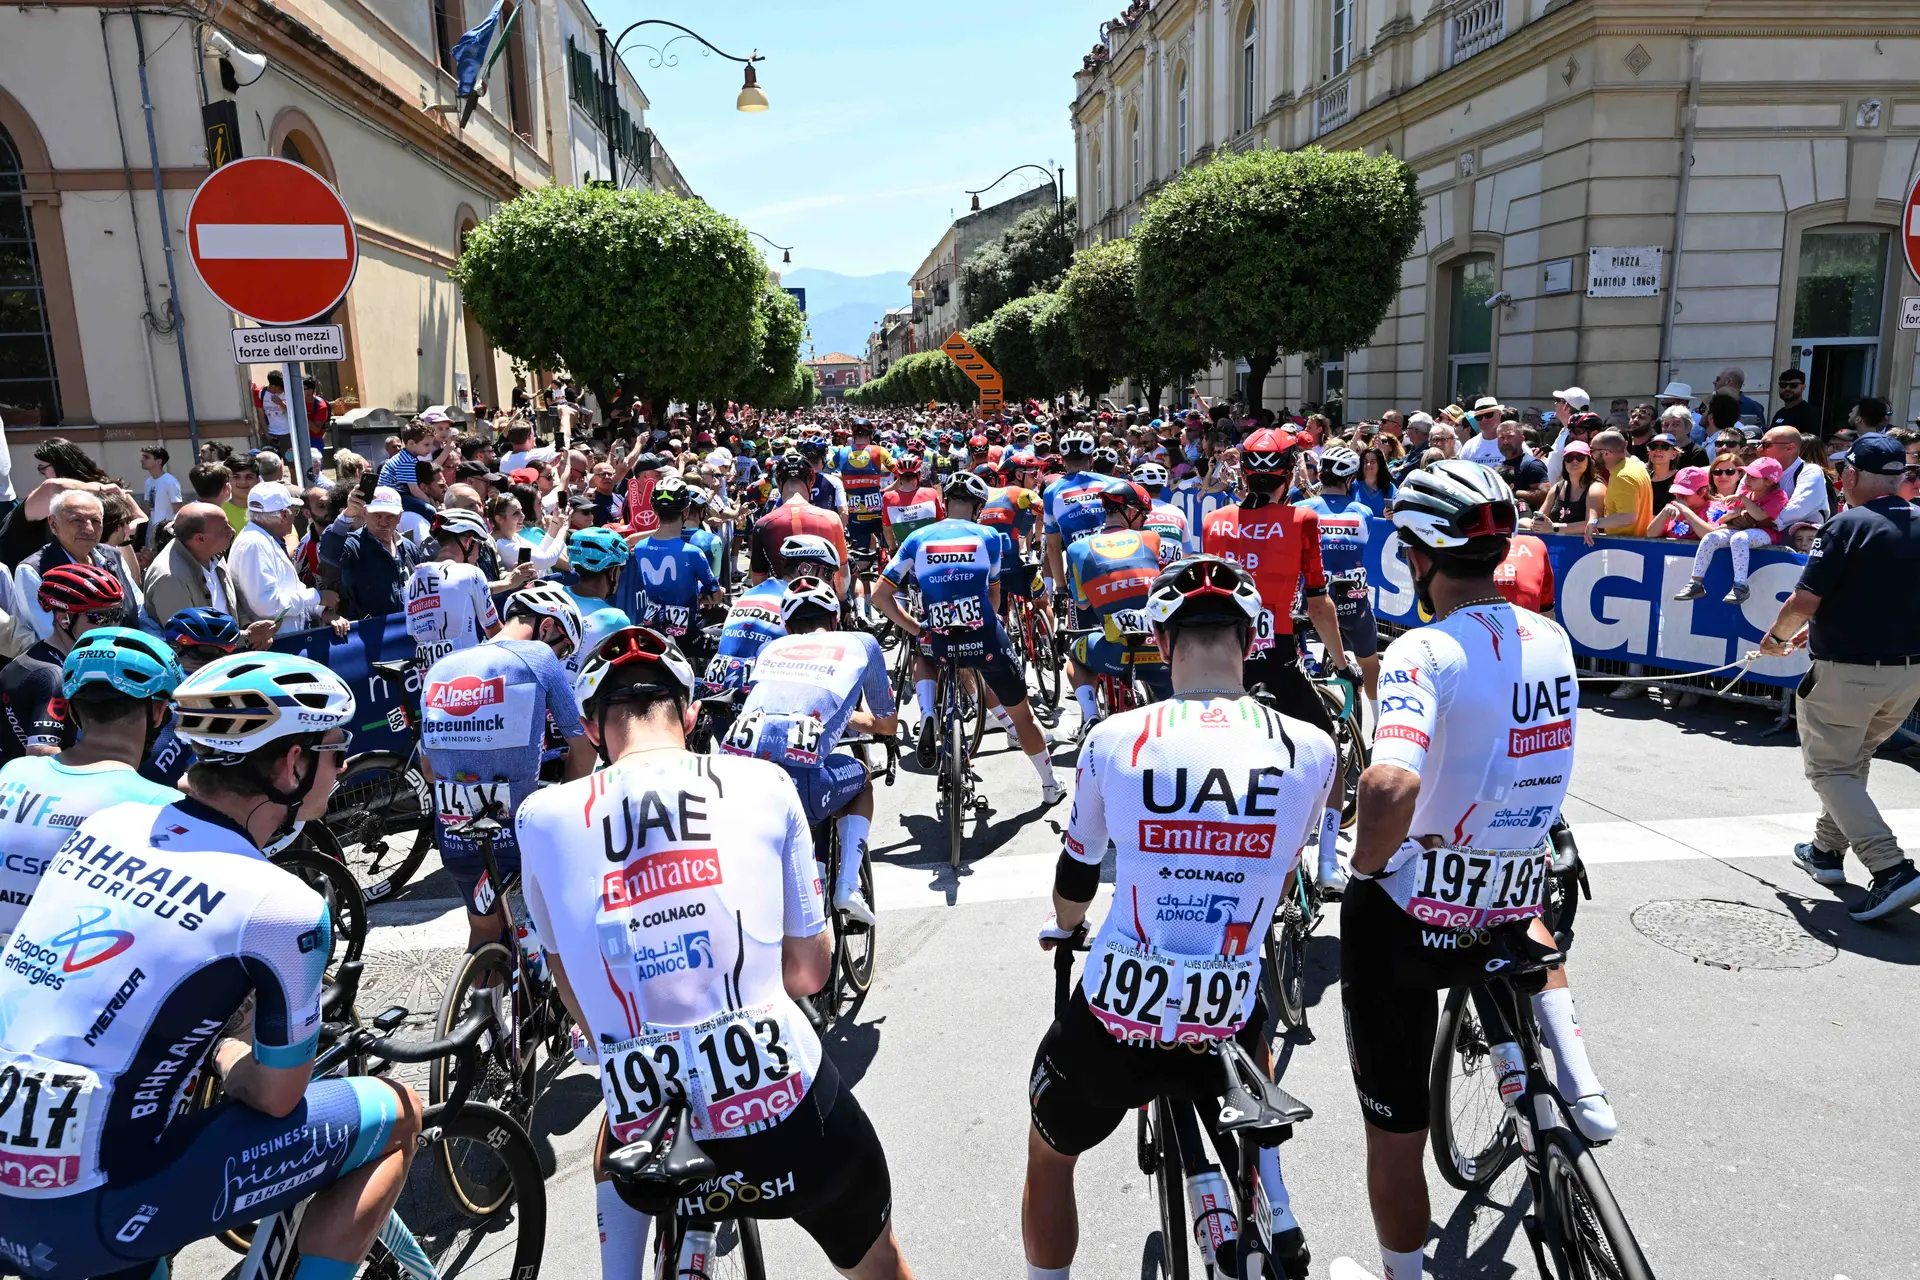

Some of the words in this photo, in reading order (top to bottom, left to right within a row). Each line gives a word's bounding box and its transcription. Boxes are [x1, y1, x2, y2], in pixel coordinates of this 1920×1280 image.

[1611, 257, 1640, 267] PIAZZA
[1593, 277, 1626, 287] BARTOLO
[1632, 276, 1656, 287] LONGO
[243, 331, 292, 343] escluso
[295, 330, 330, 341] mezzi
[239, 346, 270, 358] forze
[630, 481, 638, 506] TOYOTA
[865, 493, 880, 506] 115
[1064, 494, 1100, 506] SOUDA
[1145, 514, 1183, 527] POLTI
[1209, 520, 1284, 540] ARKEA
[926, 553, 976, 565] SOUDAL
[409, 576, 440, 601] UAE
[1096, 576, 1156, 596] TREK
[408, 597, 440, 614] Emirates
[666, 606, 689, 628] 122
[730, 608, 781, 626] SOUDAL
[957, 598, 982, 624] 135
[76, 650, 117, 660] BRIKO
[433, 683, 495, 706] Alpecin
[454, 698, 495, 708] BOOSTER
[1512, 675, 1571, 724] UAE
[297, 712, 343, 723] RUDY
[387, 708, 404, 731] 198
[204, 738, 243, 747] RUDY
[726, 717, 757, 750] 15
[793, 719, 820, 753] 15
[1513, 725, 1572, 755] Emirates
[154, 738, 182, 774] FDJ
[1142, 767, 1284, 817] UAE
[1518, 774, 1562, 788] COLNAGO
[438, 781, 465, 816] 14
[603, 789, 712, 863] UAE
[1488, 817, 1530, 829] ADNOC
[444, 840, 467, 851] SUN
[468, 839, 515, 851] SYEMS
[1144, 823, 1271, 855] Emirates
[61, 831, 227, 916] BAHRAIN
[606, 857, 720, 905] Emirates
[1174, 869, 1246, 884] COLNAGO
[1417, 851, 1492, 907] 197
[1492, 855, 1545, 908] 197
[479, 886, 492, 910] 14
[642, 903, 706, 929] COLNAGO
[1156, 909, 1205, 922] ADNOC
[1413, 904, 1477, 928] enel
[14, 934, 58, 966] Bapco
[5, 953, 66, 991] energies
[637, 958, 687, 982] ADNOC
[1184, 959, 1202, 969] ALVES
[1091, 952, 1169, 1026] 192
[83, 967, 146, 1048] MERIDA
[694, 1020, 716, 1035] BJERG
[616, 1038, 635, 1052] Mikkel
[130, 1018, 224, 1120] BAHRAIN
[698, 1017, 789, 1103] 193
[604, 1044, 688, 1125] 193
[0, 1065, 87, 1149] 217
[720, 1080, 800, 1128] enel
[241, 1124, 309, 1164] BUSINESS
[486, 1125, 507, 1149] 45
[0, 1158, 67, 1188] nel
[212, 1122, 357, 1222] friendly
[243, 1168, 316, 1208] BAHRAIN
